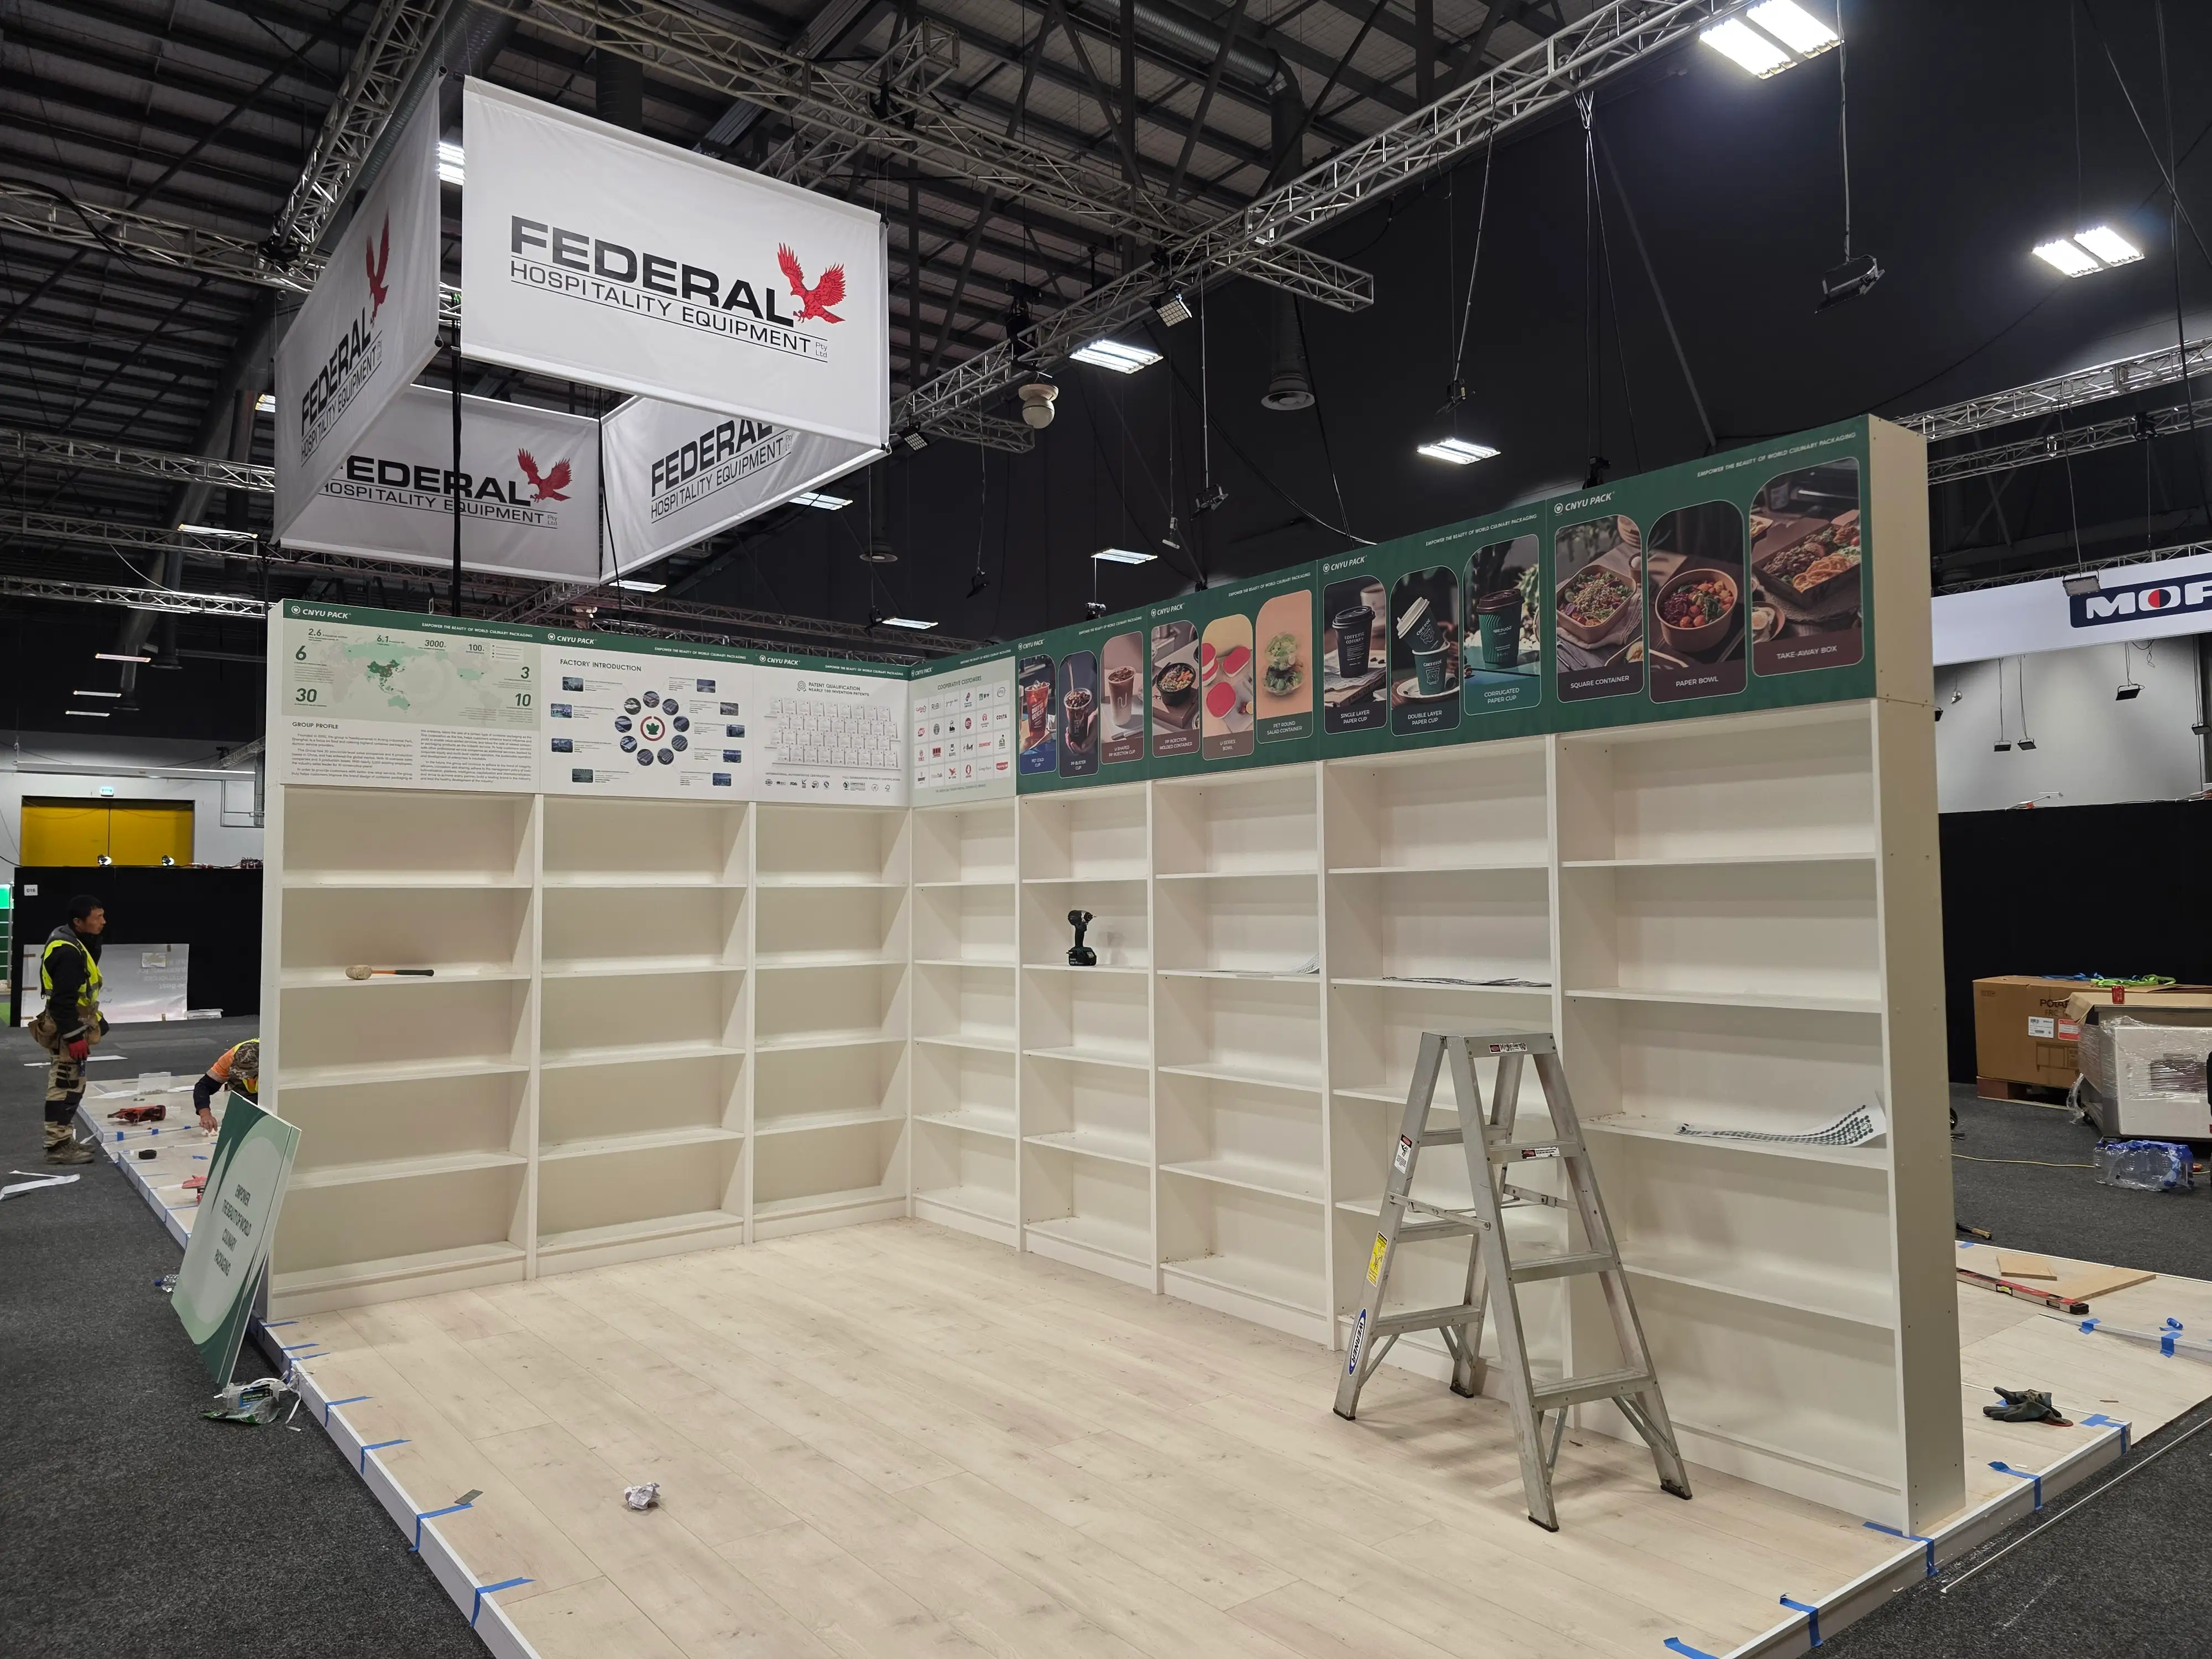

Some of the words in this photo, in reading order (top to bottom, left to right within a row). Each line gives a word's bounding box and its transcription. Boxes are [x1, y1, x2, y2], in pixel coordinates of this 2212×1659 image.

[511, 215, 794, 327] FEDERAL
[510, 260, 671, 316] HOSPITALITY
[682, 307, 811, 353] EQUIPMENT
[815, 342, 827, 351] Pty
[816, 349, 827, 358] Ltd
[301, 306, 371, 437] FEDERAL
[301, 400, 337, 462] HOSPITALITY
[338, 343, 377, 414] EQUIPMENT
[651, 419, 773, 497] FEDERAL
[1697, 466, 1724, 477] EMPOWER
[1736, 457, 1756, 467] BEAUTY
[1767, 450, 1788, 459] WORLD
[1789, 442, 1818, 453] CULINARY
[1819, 432, 1856, 446] PACKAGING
[347, 455, 531, 507] EDERAL
[651, 473, 713, 519] HOSPITALITY
[716, 437, 784, 487] EQUIPMENT
[1565, 499, 1588, 511] CNYU
[1590, 492, 1613, 504] PACK
[1426, 537, 1444, 546] EMPOWER
[1490, 520, 1510, 529] CULINARY
[1511, 514, 1537, 524] PACKAGING
[1331, 561, 1348, 571] CNYU
[1349, 556, 1365, 566] PACK
[1291, 572, 1311, 580] PACKAGING
[1157, 607, 1170, 615] CNYU
[1170, 603, 1183, 612] PACK
[308, 628, 322, 637] 2.6
[295, 645, 307, 660] 6
[1776, 648, 1819, 659] TAKE-AWAY
[520, 666, 530, 679] 3
[592, 662, 641, 671] INTRODUCTION
[937, 680, 961, 690] COOPERATIVE
[961, 675, 982, 685] CUSTOMERS
[1571, 680, 1594, 688] SQUARE
[1595, 675, 1629, 685] CONTAINER
[295, 688, 317, 702] 30
[1484, 687, 1519, 697] CORRUGATED
[515, 693, 531, 707] 10
[1352, 1322, 1364, 1363] WERNER
